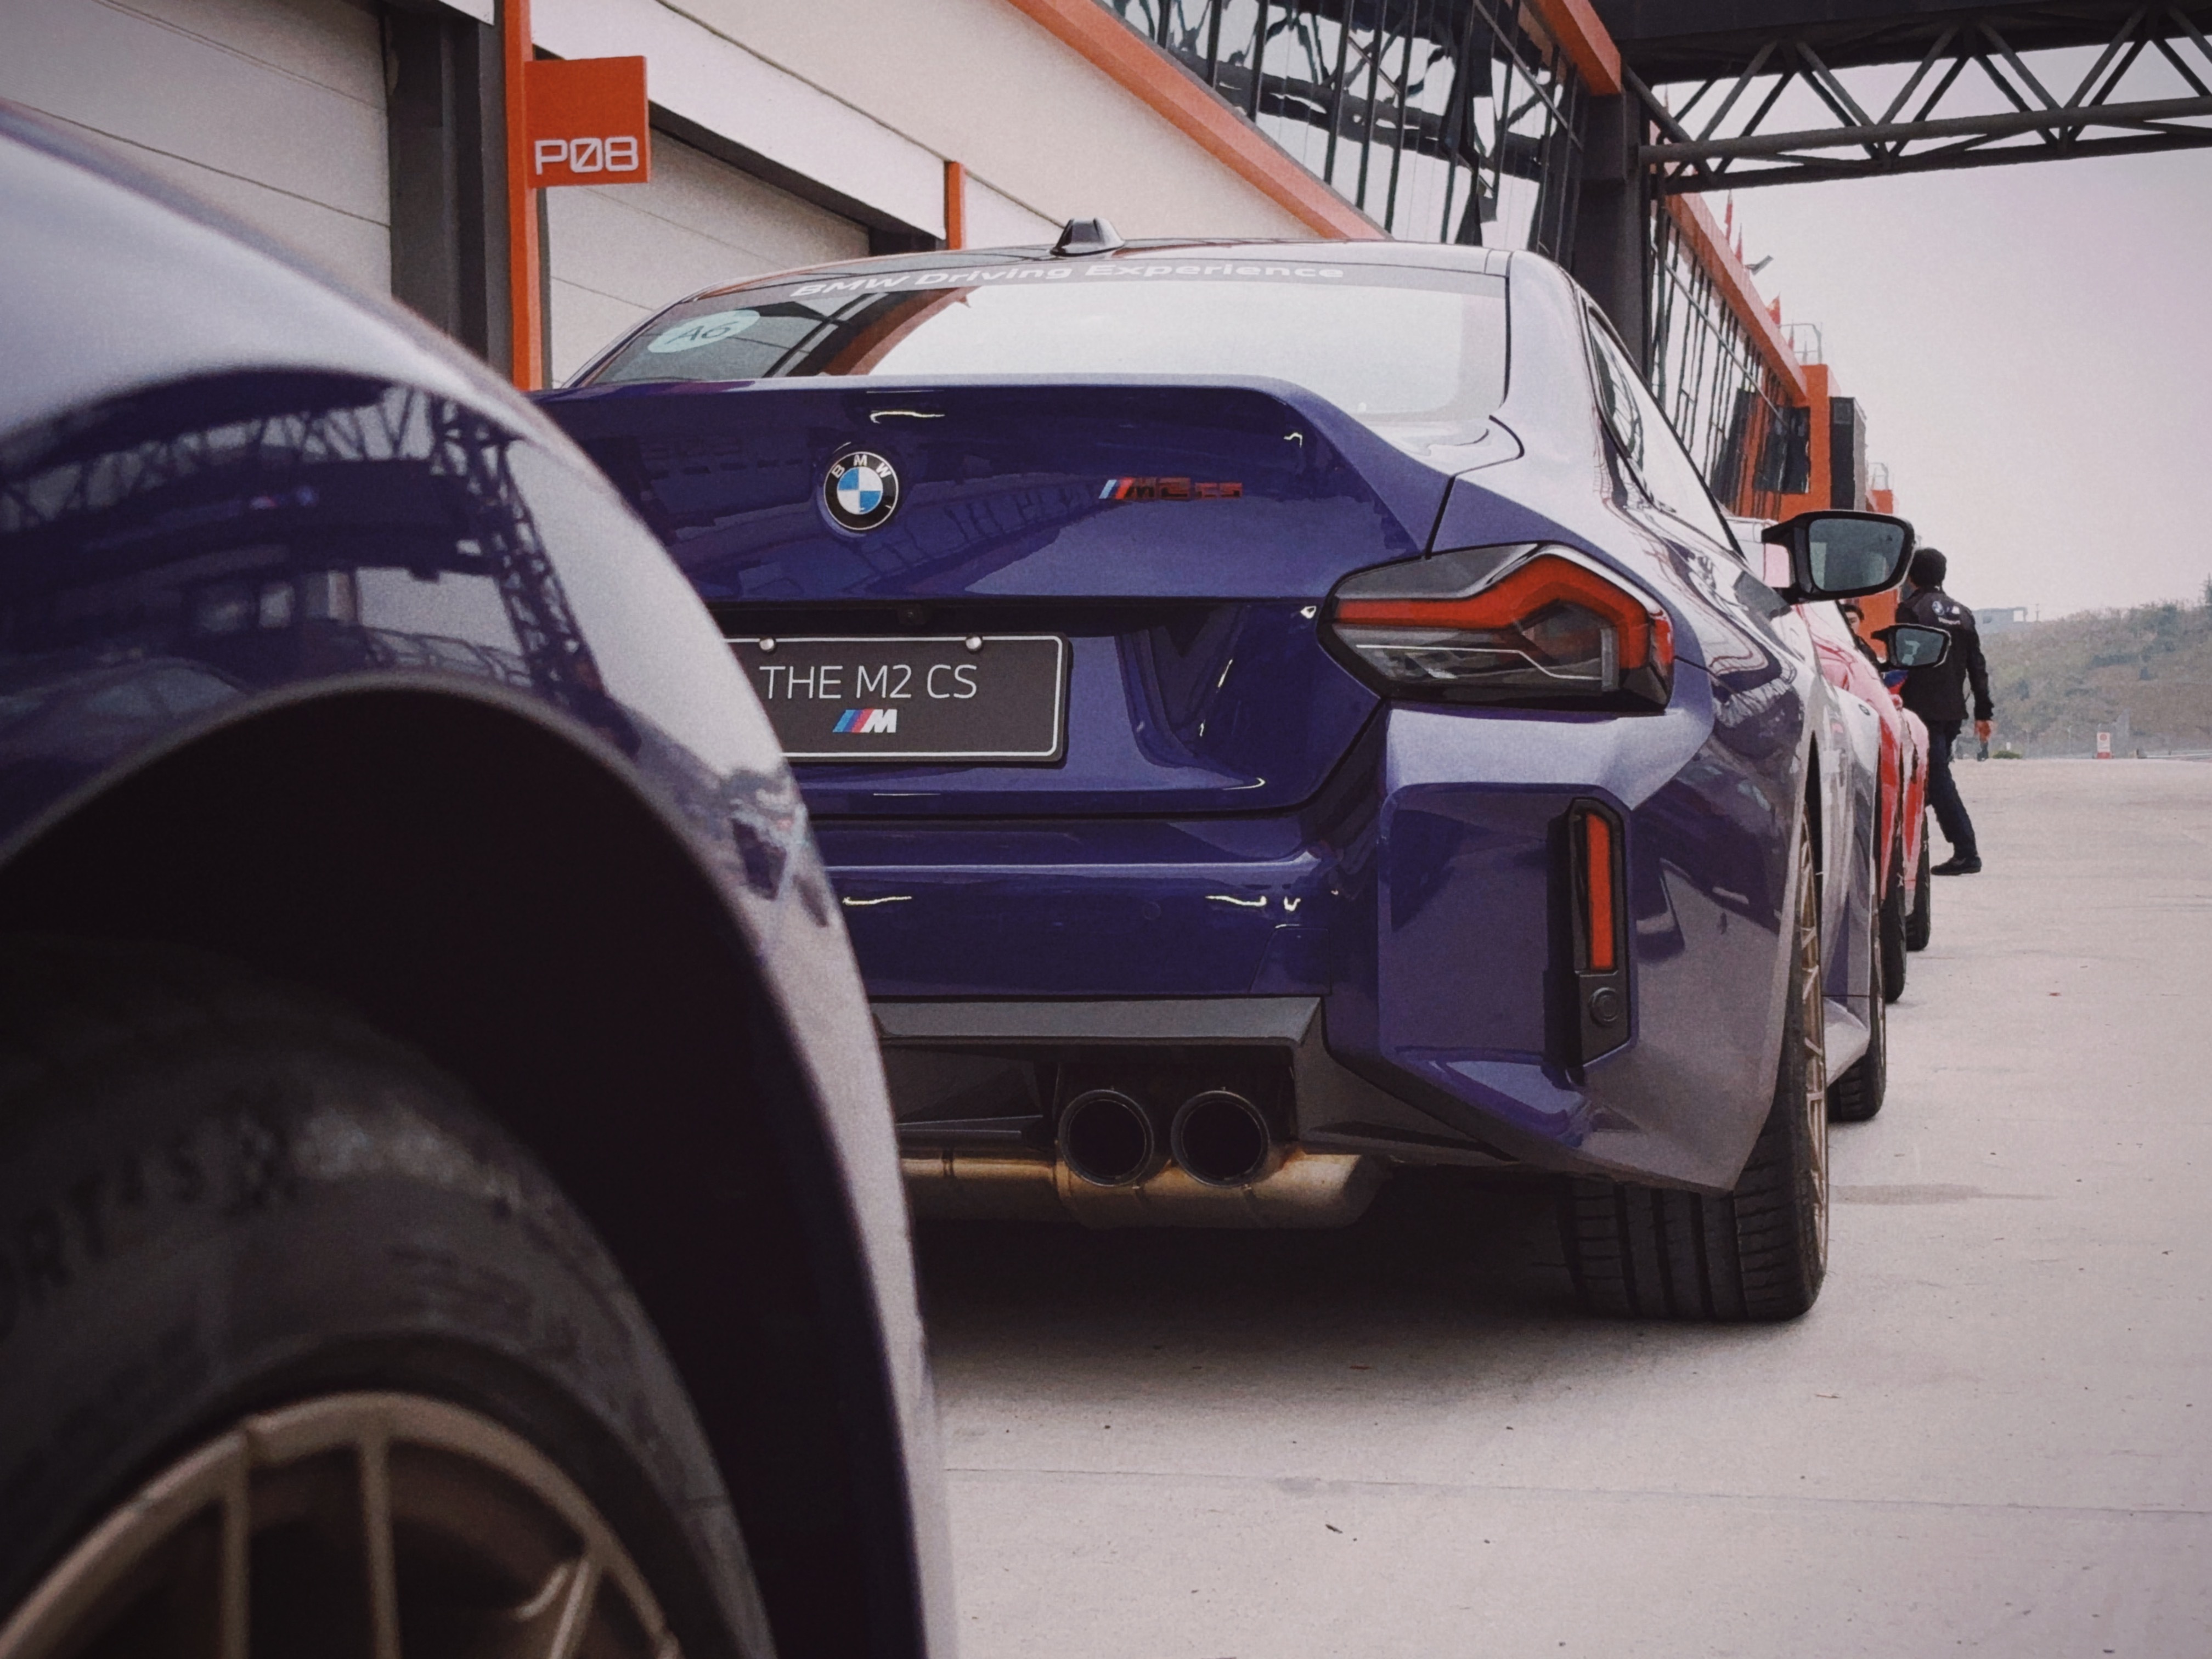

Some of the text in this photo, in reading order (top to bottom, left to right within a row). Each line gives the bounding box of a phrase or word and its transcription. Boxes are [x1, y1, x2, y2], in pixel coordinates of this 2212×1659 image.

[789, 263, 1344, 297] BMW Driving Experience
[664, 320, 740, 345] A6
[831, 454, 892, 478] BMW
[759, 664, 978, 699] THE M2 CS
